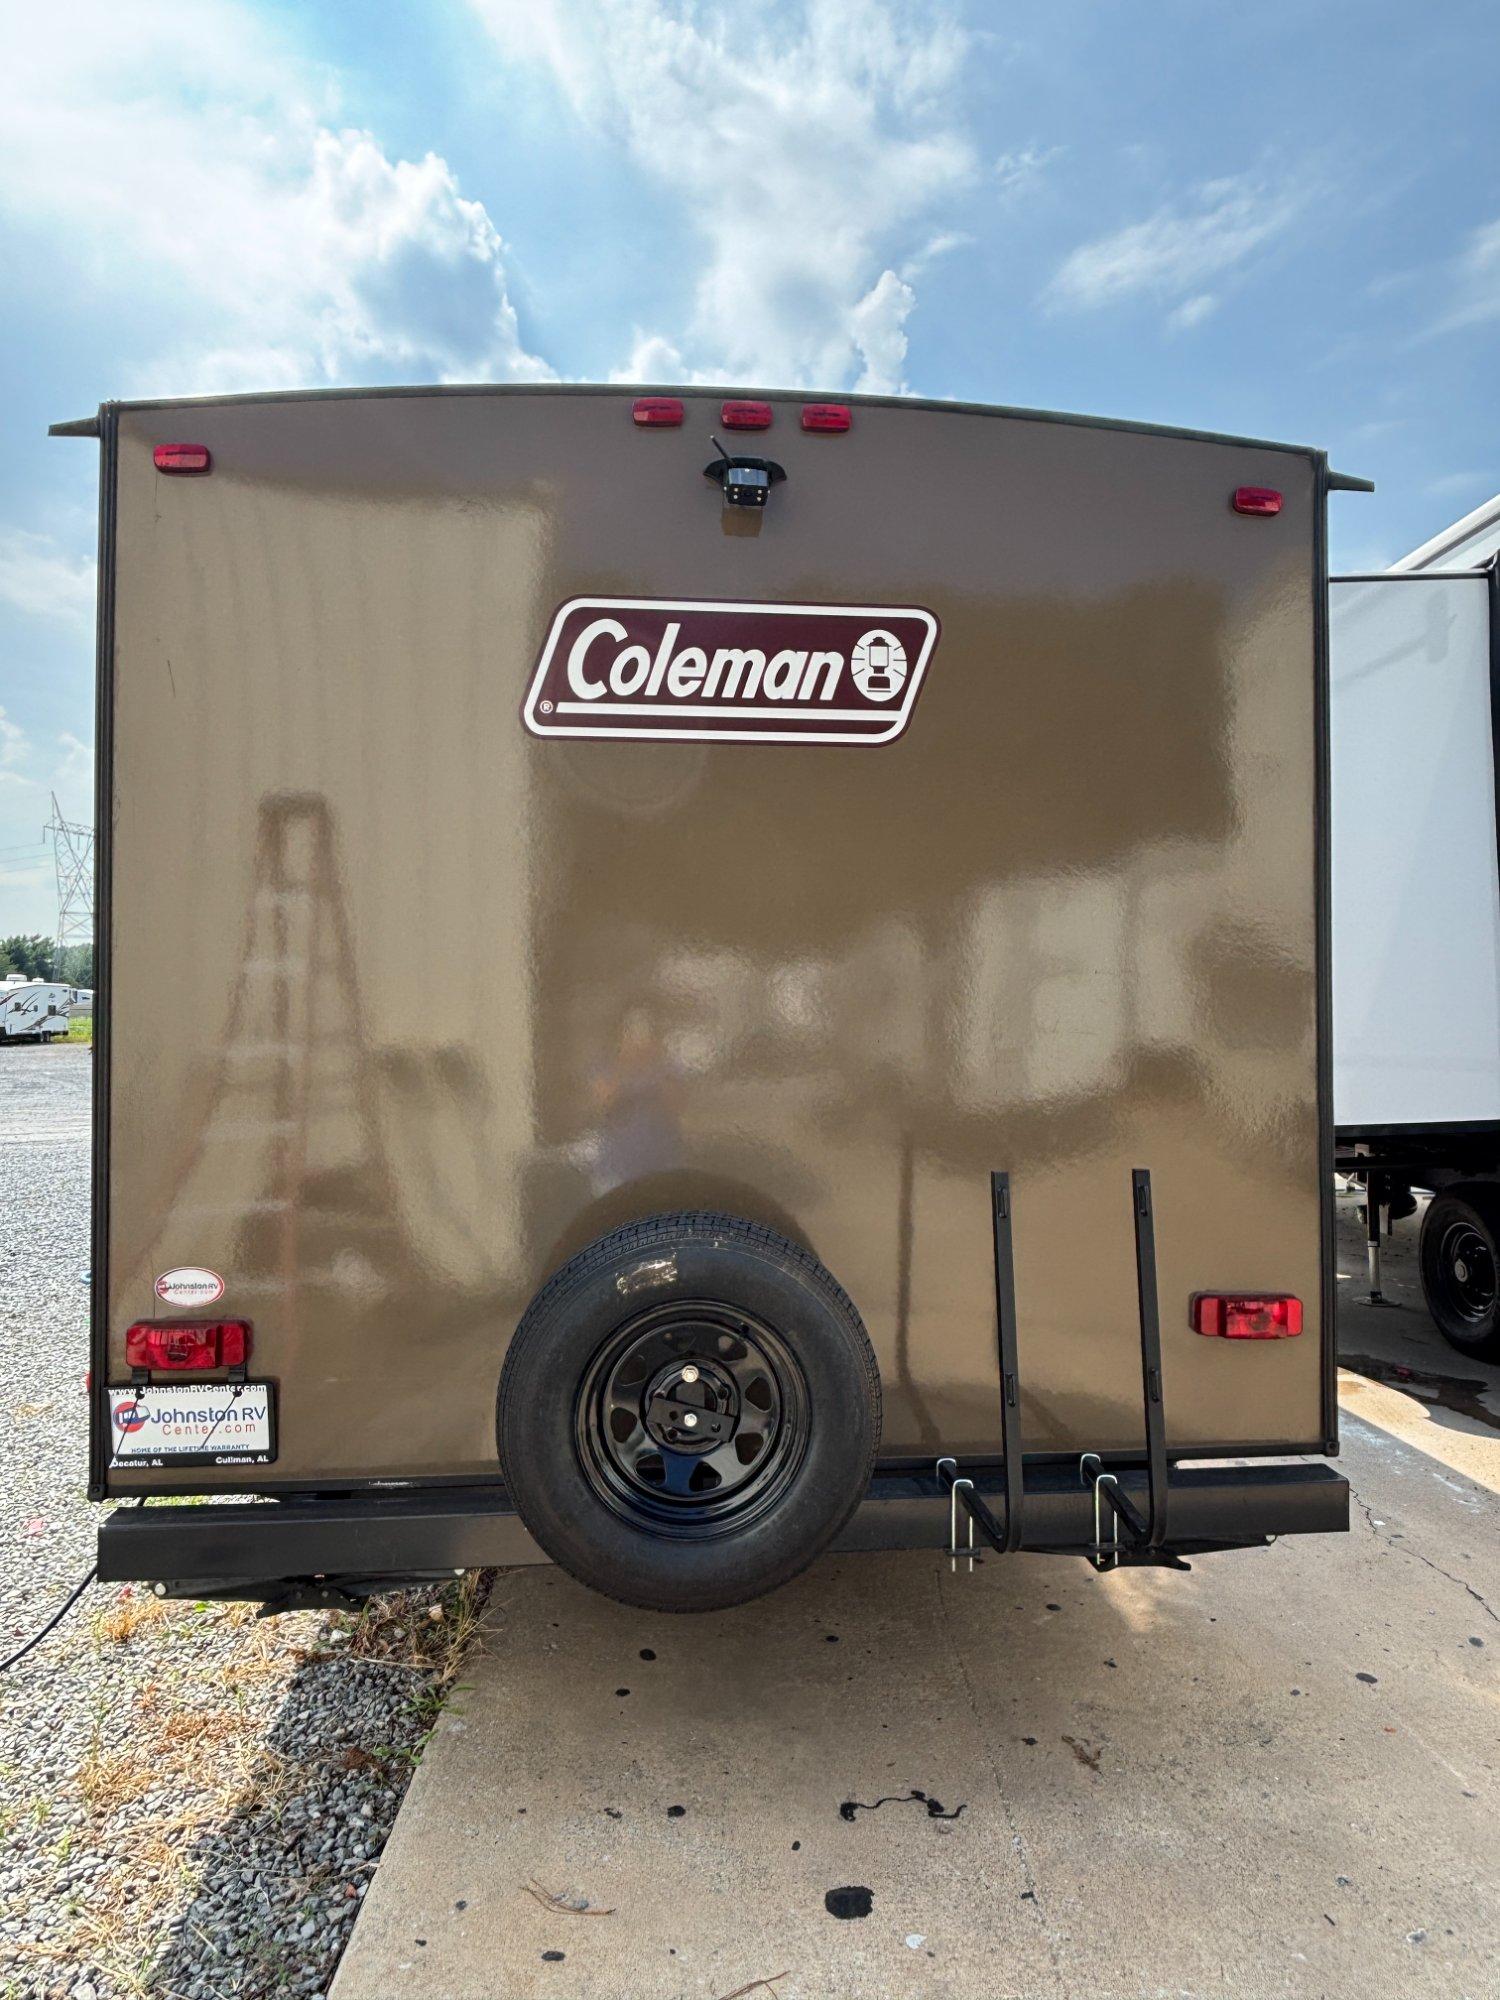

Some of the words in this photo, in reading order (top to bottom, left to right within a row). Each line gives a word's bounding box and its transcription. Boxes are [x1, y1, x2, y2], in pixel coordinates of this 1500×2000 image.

[567, 618, 845, 700] Coleman
[151, 1407, 238, 1424] Johnston
[242, 1406, 266, 1421] RV
[151, 1458, 164, 1467] AL
[215, 1456, 254, 1465] Cullman,
[256, 1455, 269, 1463] AL
